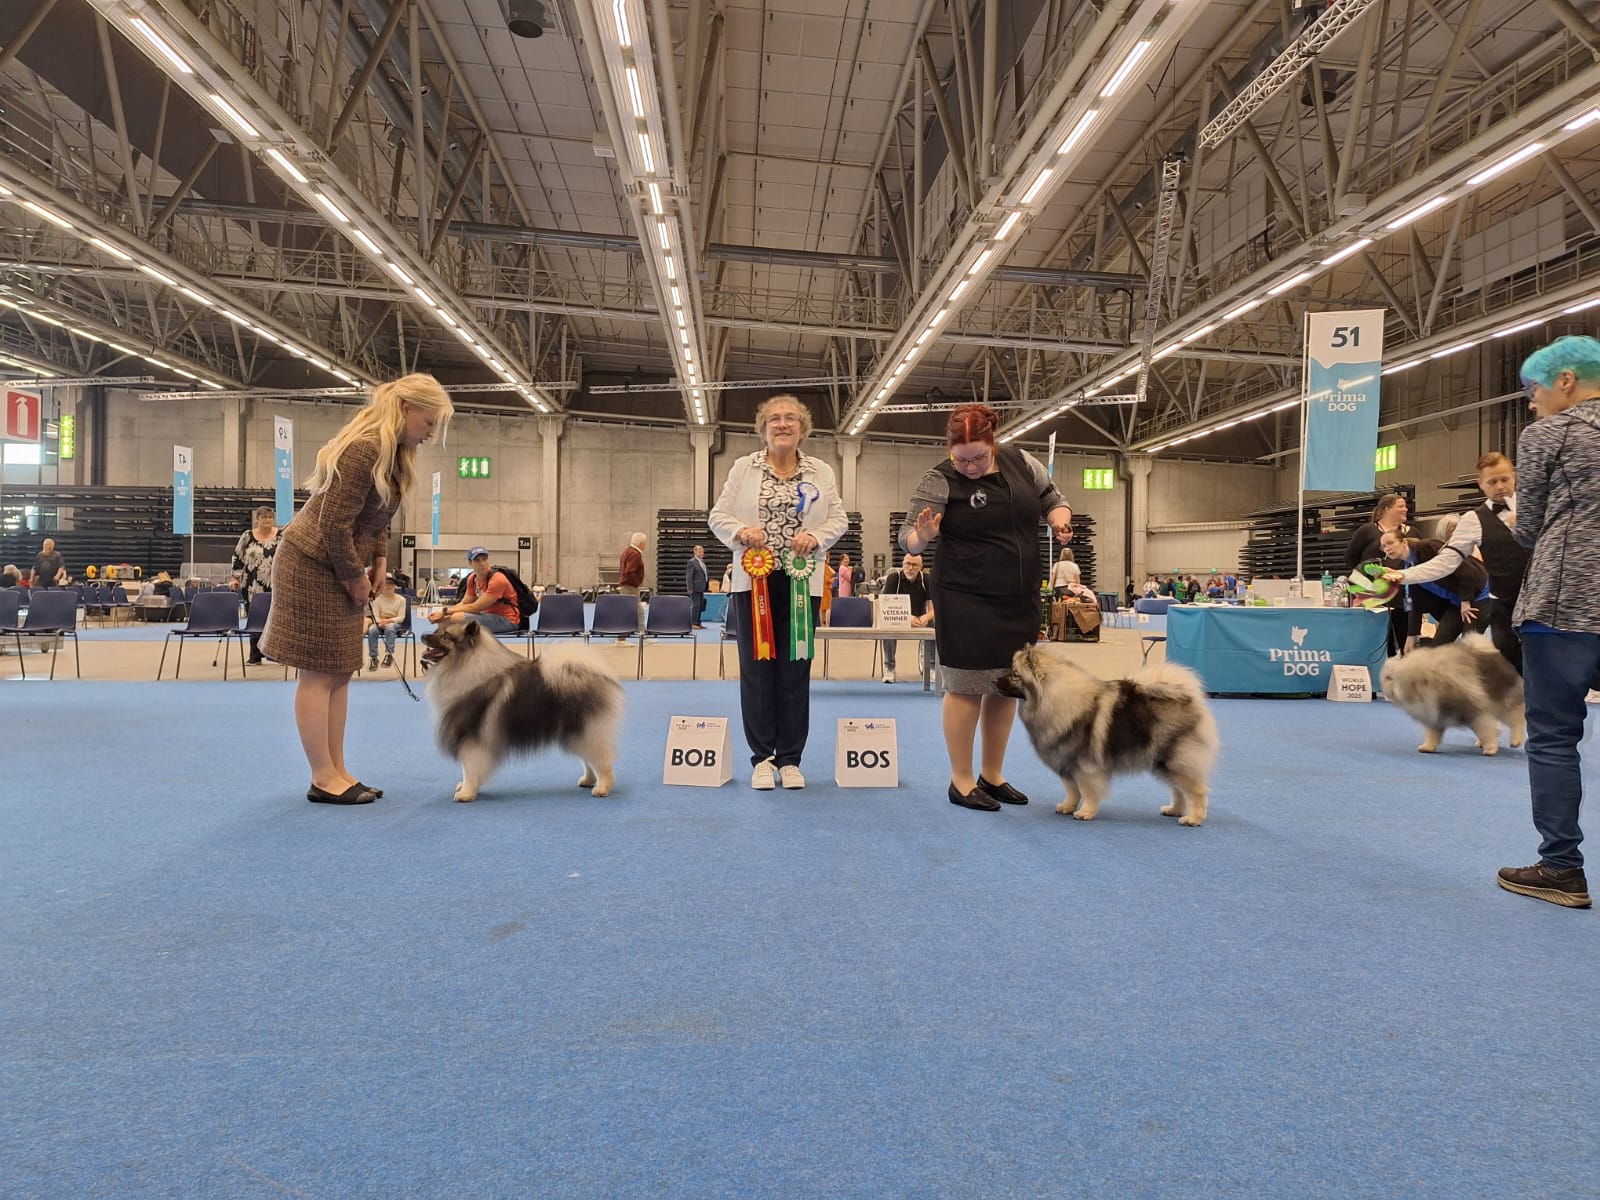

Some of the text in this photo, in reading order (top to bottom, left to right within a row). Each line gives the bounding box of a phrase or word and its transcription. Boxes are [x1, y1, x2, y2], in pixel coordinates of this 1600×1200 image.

[1331, 326, 1360, 348] 51
[1319, 390, 1367, 402] Prima
[1328, 402, 1357, 412] DOG
[1269, 645, 1332, 662] Prima
[1283, 663, 1320, 677] DOG
[1341, 684, 1367, 692] HOPE
[671, 748, 716, 767] BOB
[846, 750, 890, 769] BOS
